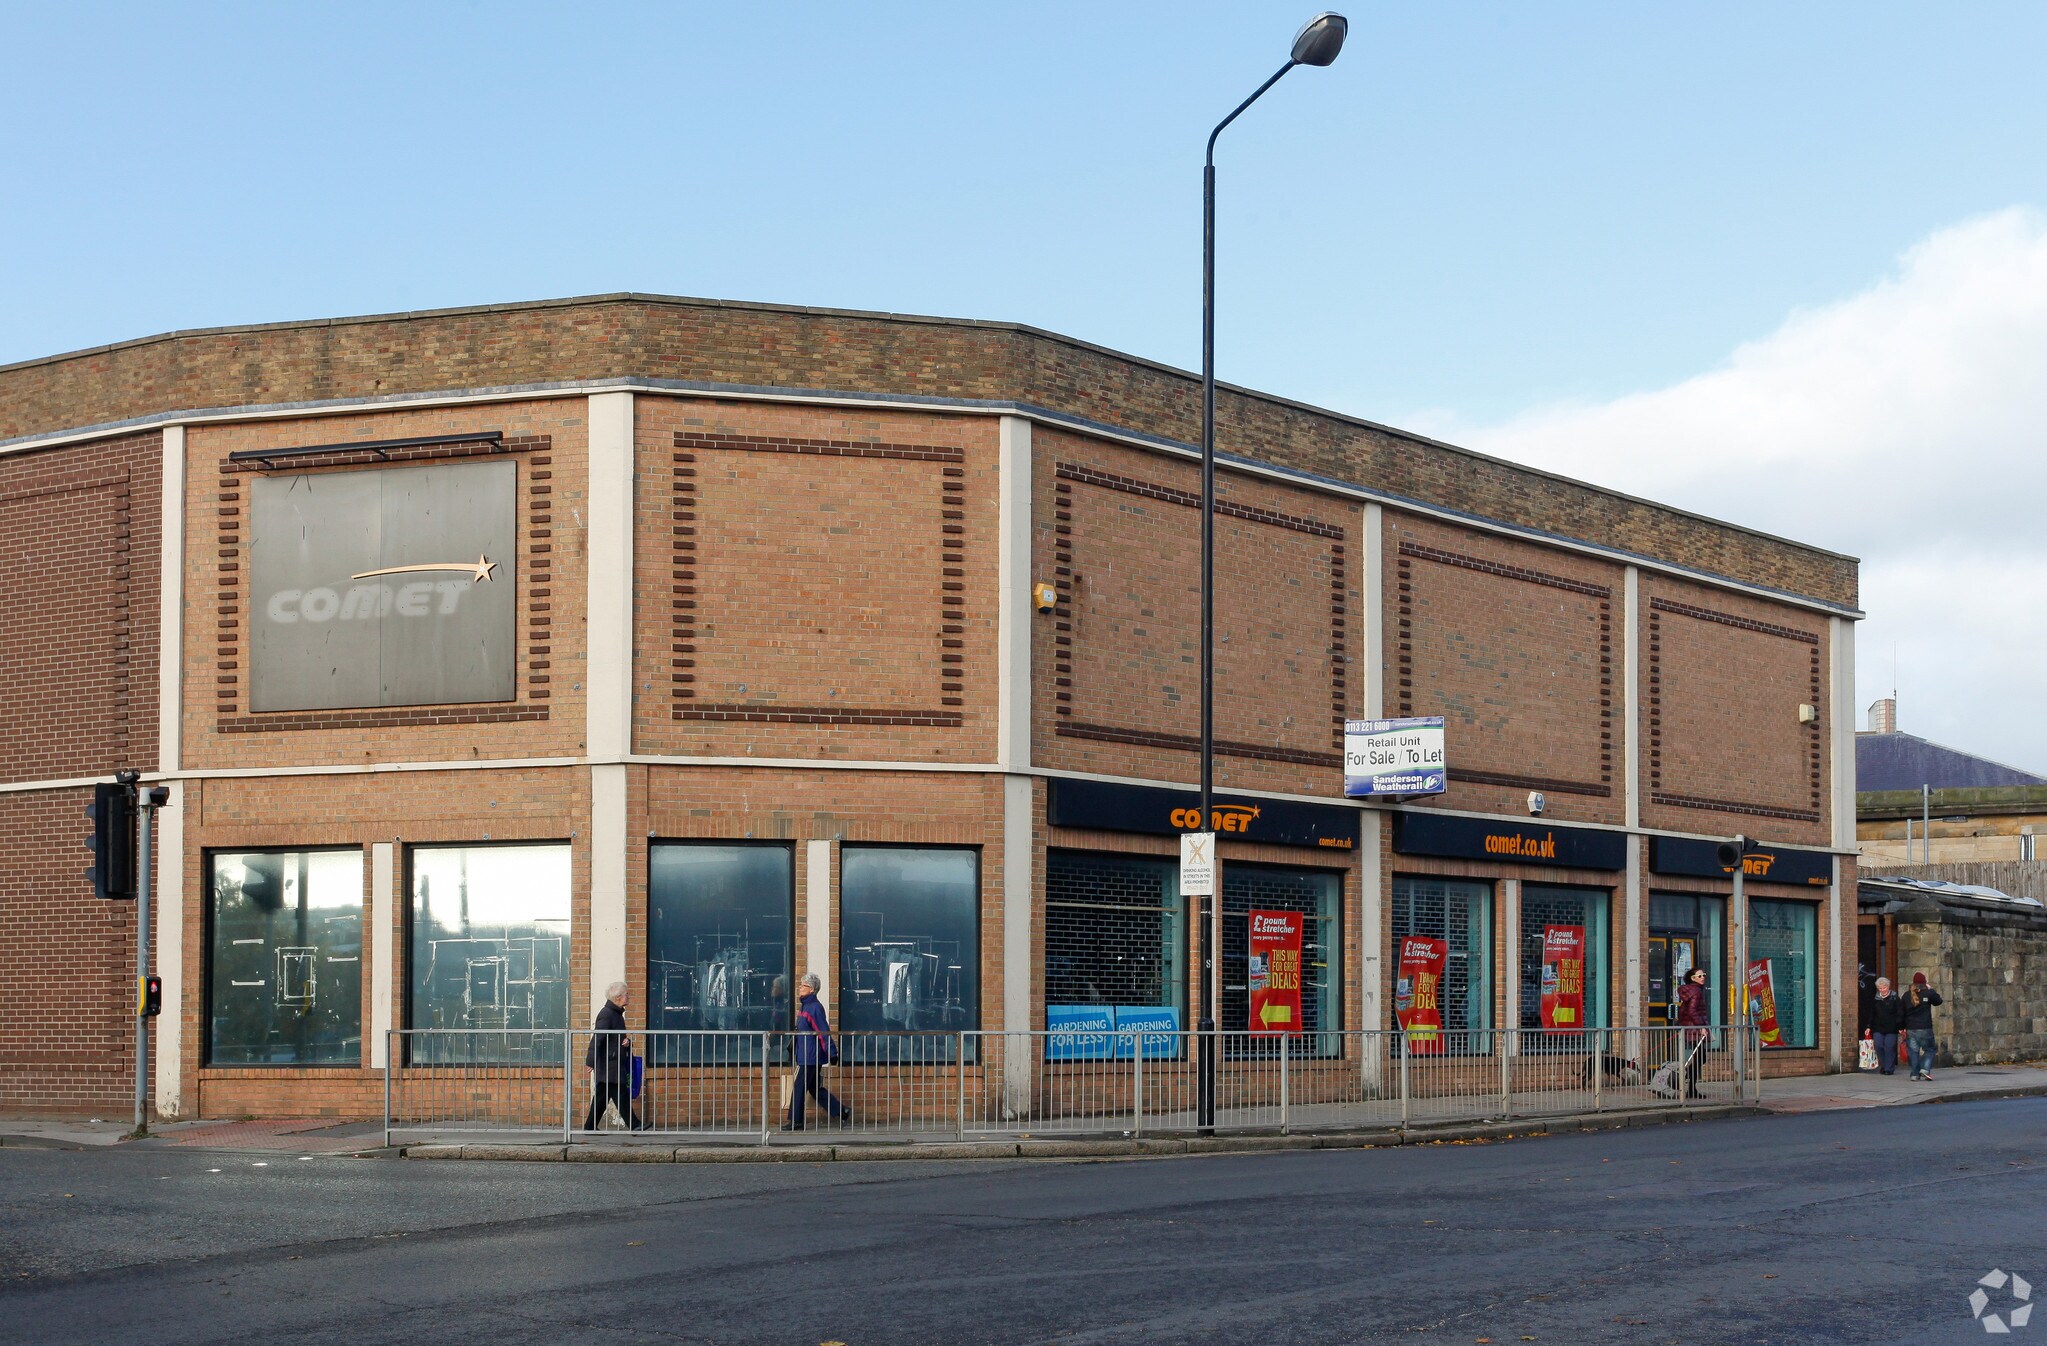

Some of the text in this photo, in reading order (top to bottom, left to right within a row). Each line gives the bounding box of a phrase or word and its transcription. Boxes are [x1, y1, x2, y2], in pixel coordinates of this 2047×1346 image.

[267, 579, 471, 624] COMET
[1345, 721, 1390, 732] 0113 221 6000
[1367, 736, 1421, 748] Retail Unit
[1346, 751, 1366, 766] For
[1369, 750, 1396, 765] Sale
[1406, 749, 1420, 763] To
[1423, 748, 1442, 763] Let
[1372, 775, 1423, 791] Sanderson Weatherall
[1485, 831, 1555, 858] comet.co.uk
[1263, 916, 1287, 926] pound
[1262, 925, 1295, 934] stretcher
[1554, 930, 1573, 938] pound
[1553, 937, 1579, 945] stretcher
[1272, 949, 1299, 962] THIS WAY
[1205, 959, 1212, 969] S
[1272, 961, 1299, 972] FOR GREAT
[1272, 972, 1298, 990] DEALS
[1417, 993, 1436, 1010] DEA
[1050, 1019, 1107, 1032] GARDENING
[1118, 1019, 1172, 1032] GARDENING
[1050, 1033, 1075, 1047] FOR
[1118, 1033, 1136, 1047] FO
